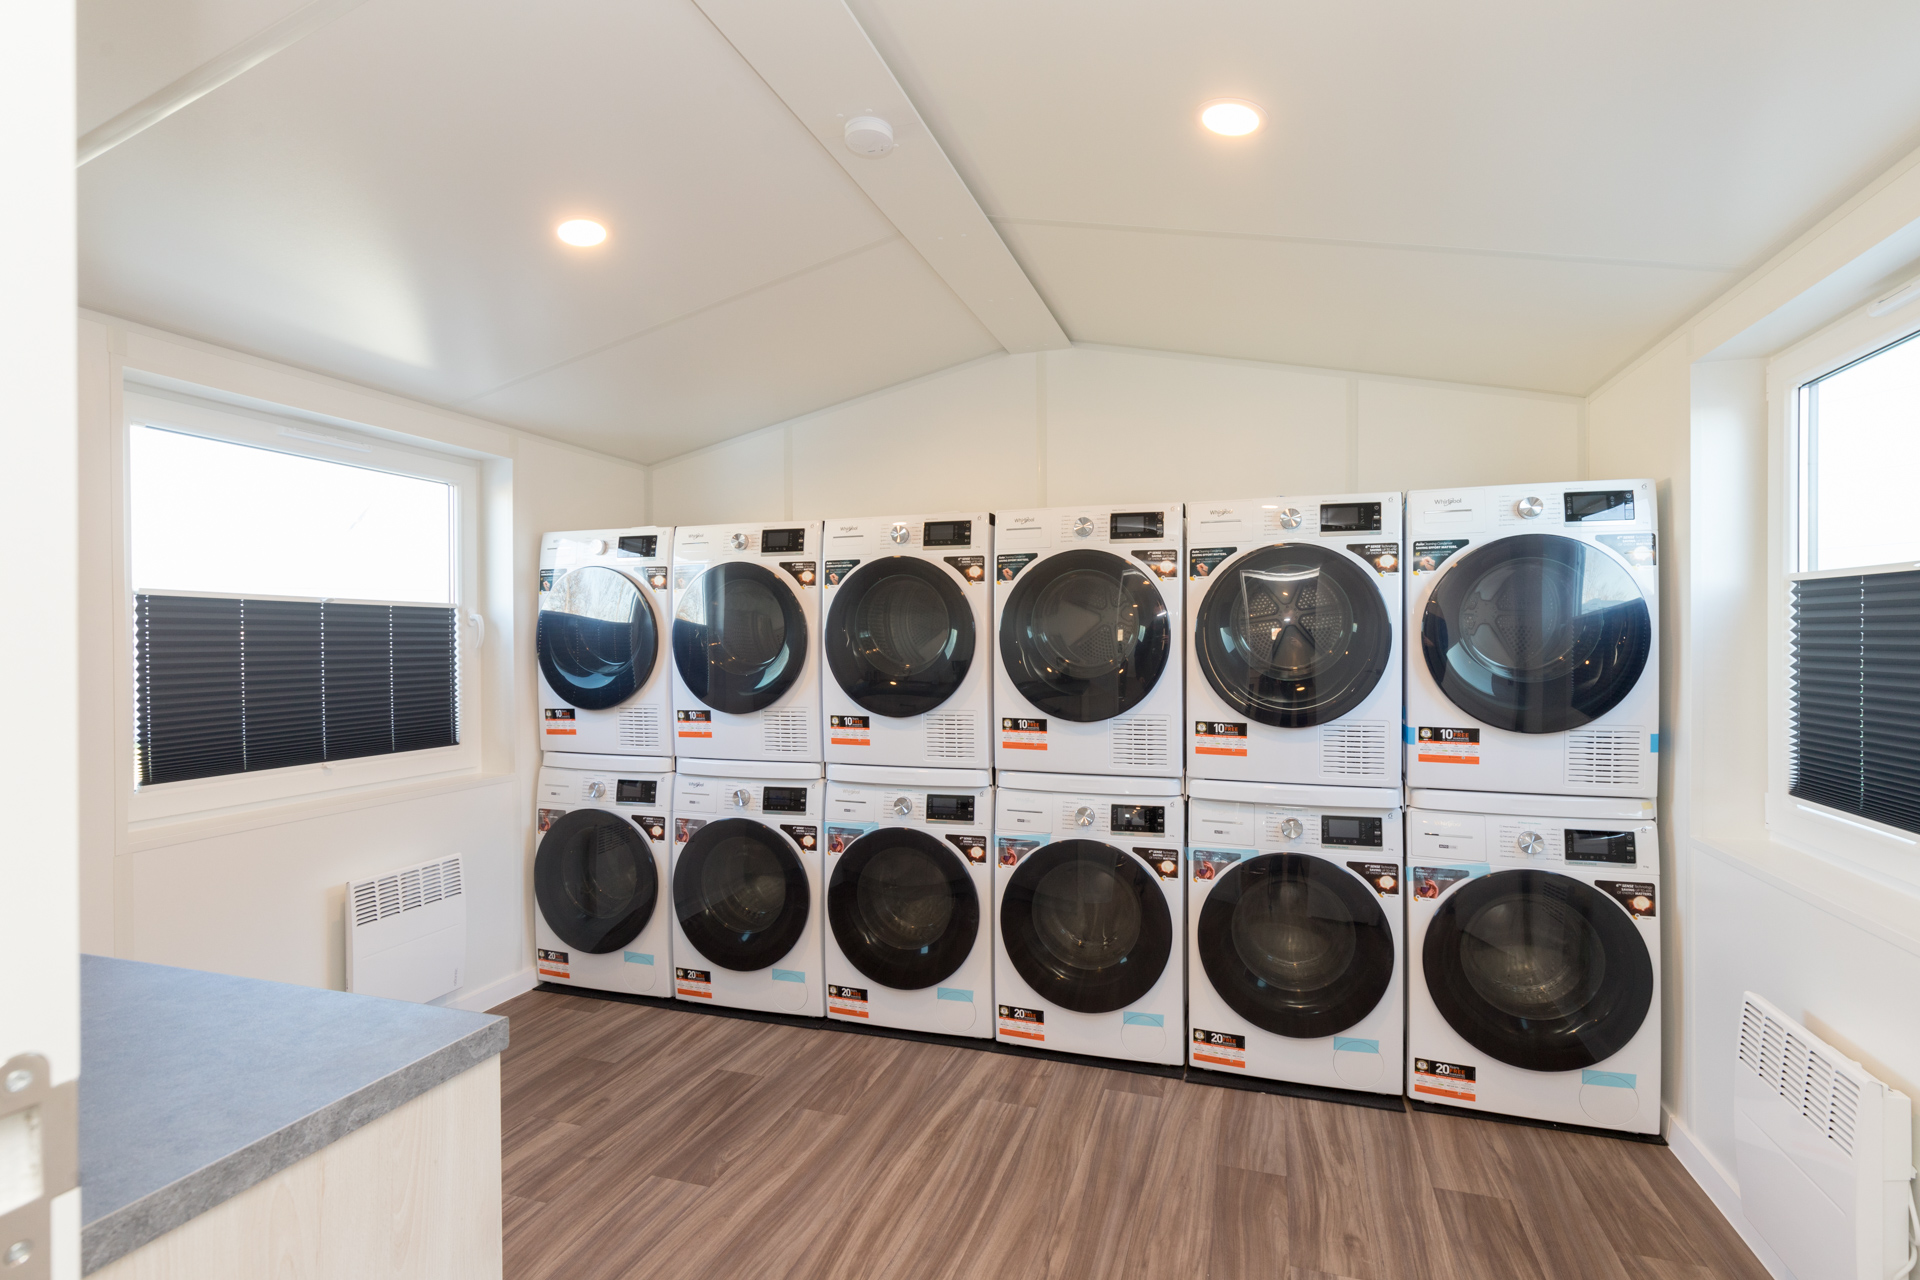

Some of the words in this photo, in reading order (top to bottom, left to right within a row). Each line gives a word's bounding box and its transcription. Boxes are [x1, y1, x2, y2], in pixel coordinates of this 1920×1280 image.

[1433, 498, 1462, 506] Whirlpool
[555, 710, 562, 718] 10
[688, 711, 696, 719] 10
[844, 717, 852, 725] 10
[1017, 719, 1027, 729] 10
[1213, 723, 1225, 733] 10
[1440, 729, 1453, 739] 10
[548, 951, 556, 959] 20
[687, 970, 696, 979] 20
[841, 987, 851, 997] 20
[1013, 1008, 1025, 1018] 20
[1210, 1033, 1223, 1043] 20
[1435, 1063, 1450, 1074] 20
